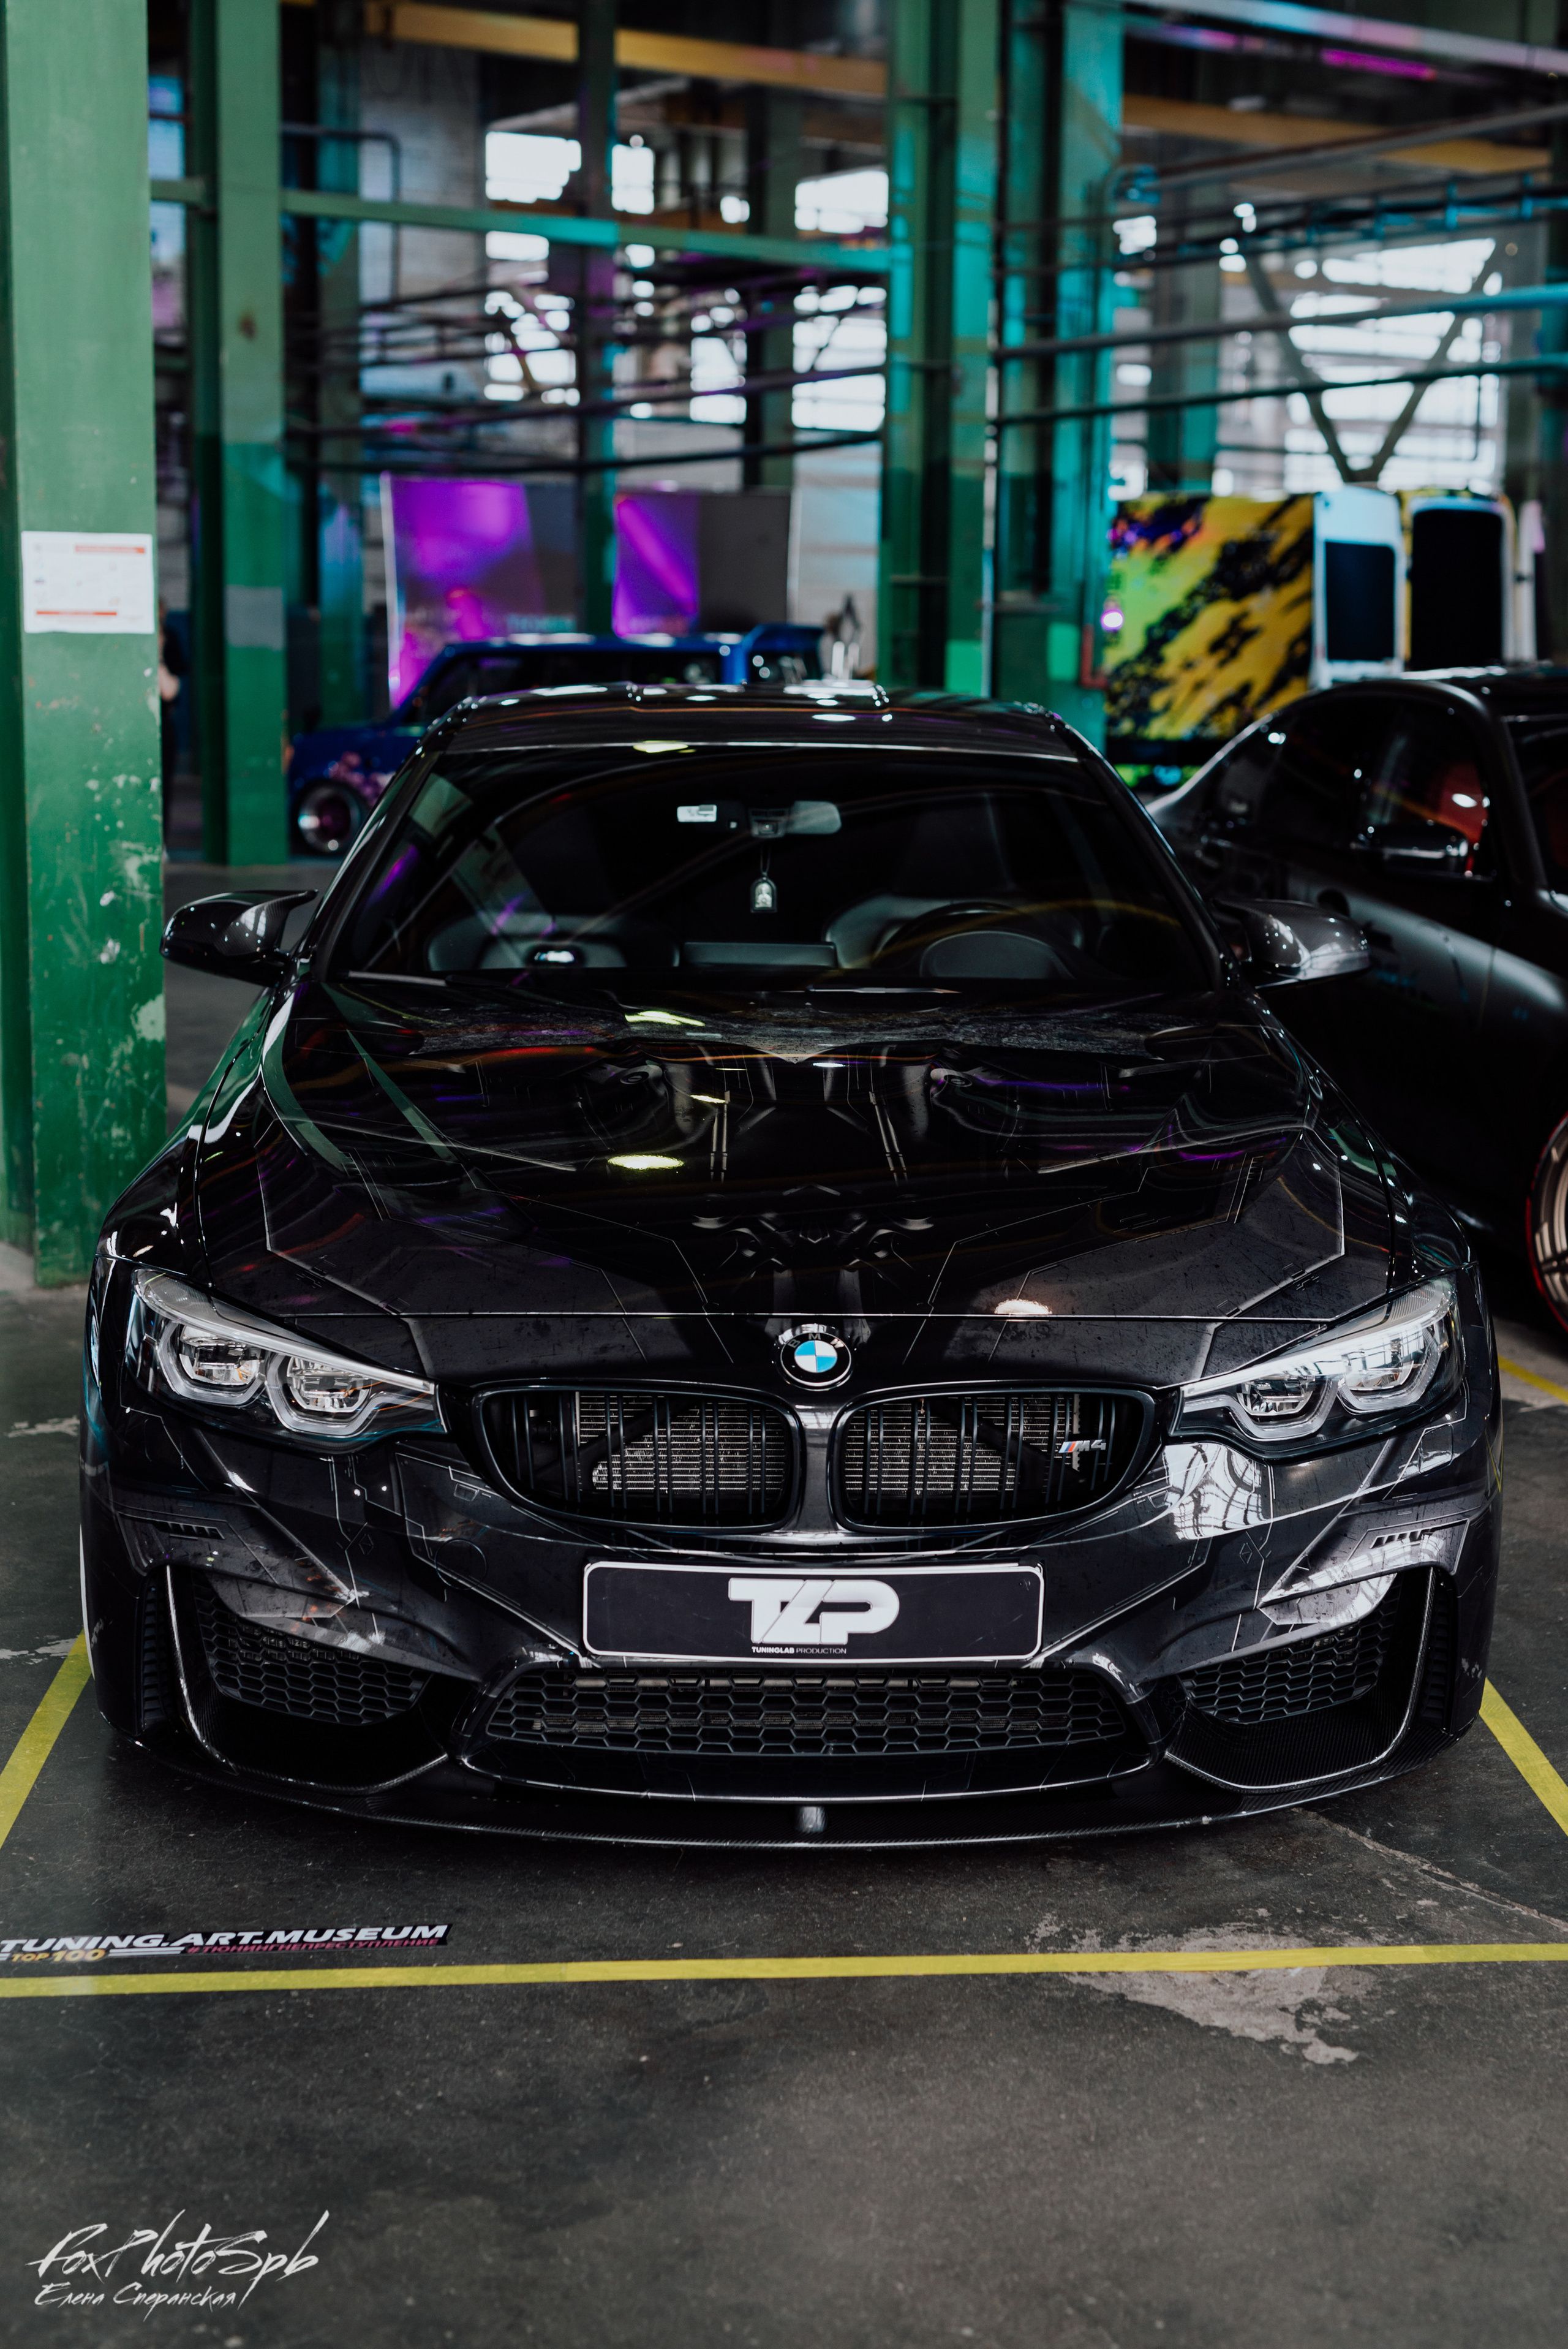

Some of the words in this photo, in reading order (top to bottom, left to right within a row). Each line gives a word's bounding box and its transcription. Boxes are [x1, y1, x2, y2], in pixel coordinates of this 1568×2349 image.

[788, 1333, 845, 1348] BMW
[11, 1952, 50, 1962] TOP
[51, 1948, 106, 1962] 100
